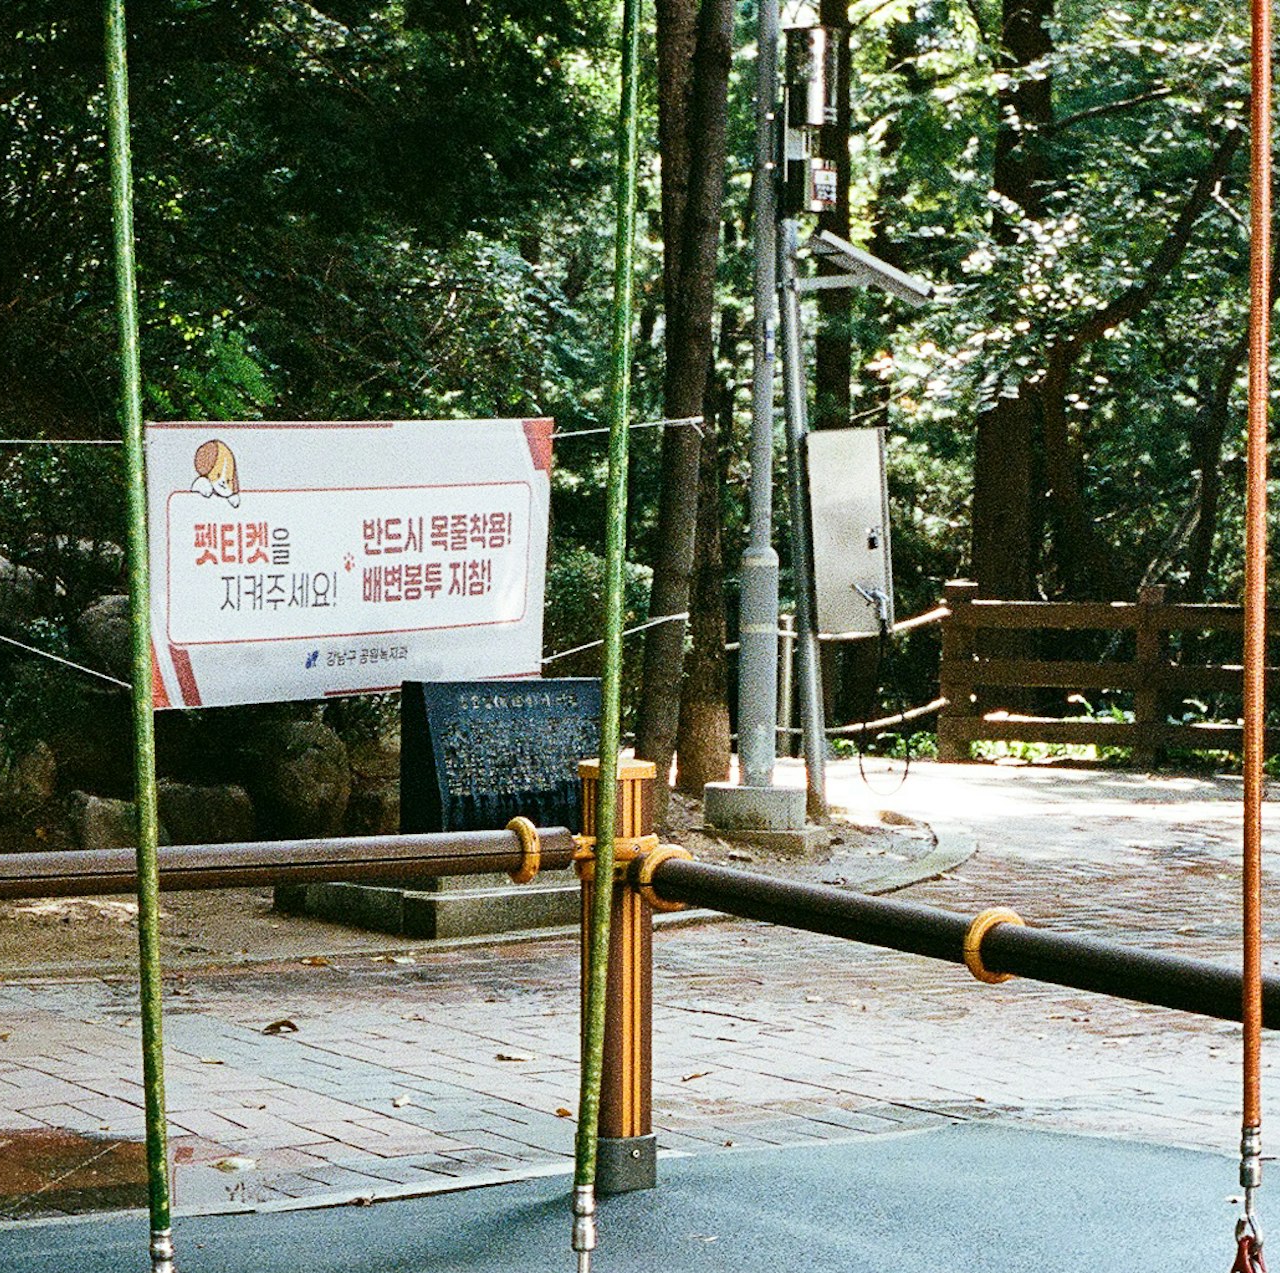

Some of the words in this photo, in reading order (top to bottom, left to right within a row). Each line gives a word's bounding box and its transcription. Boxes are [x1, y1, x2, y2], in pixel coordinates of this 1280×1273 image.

[194, 521, 290, 565] 펫티켓을
[363, 516, 423, 555] 반드시
[431, 512, 512, 551] 목줄착용!
[220, 571, 337, 611] 지켜주세요!
[363, 563, 442, 603] 배변봉투
[448, 559, 491, 597] 지참!
[326, 650, 356, 667] 강남구
